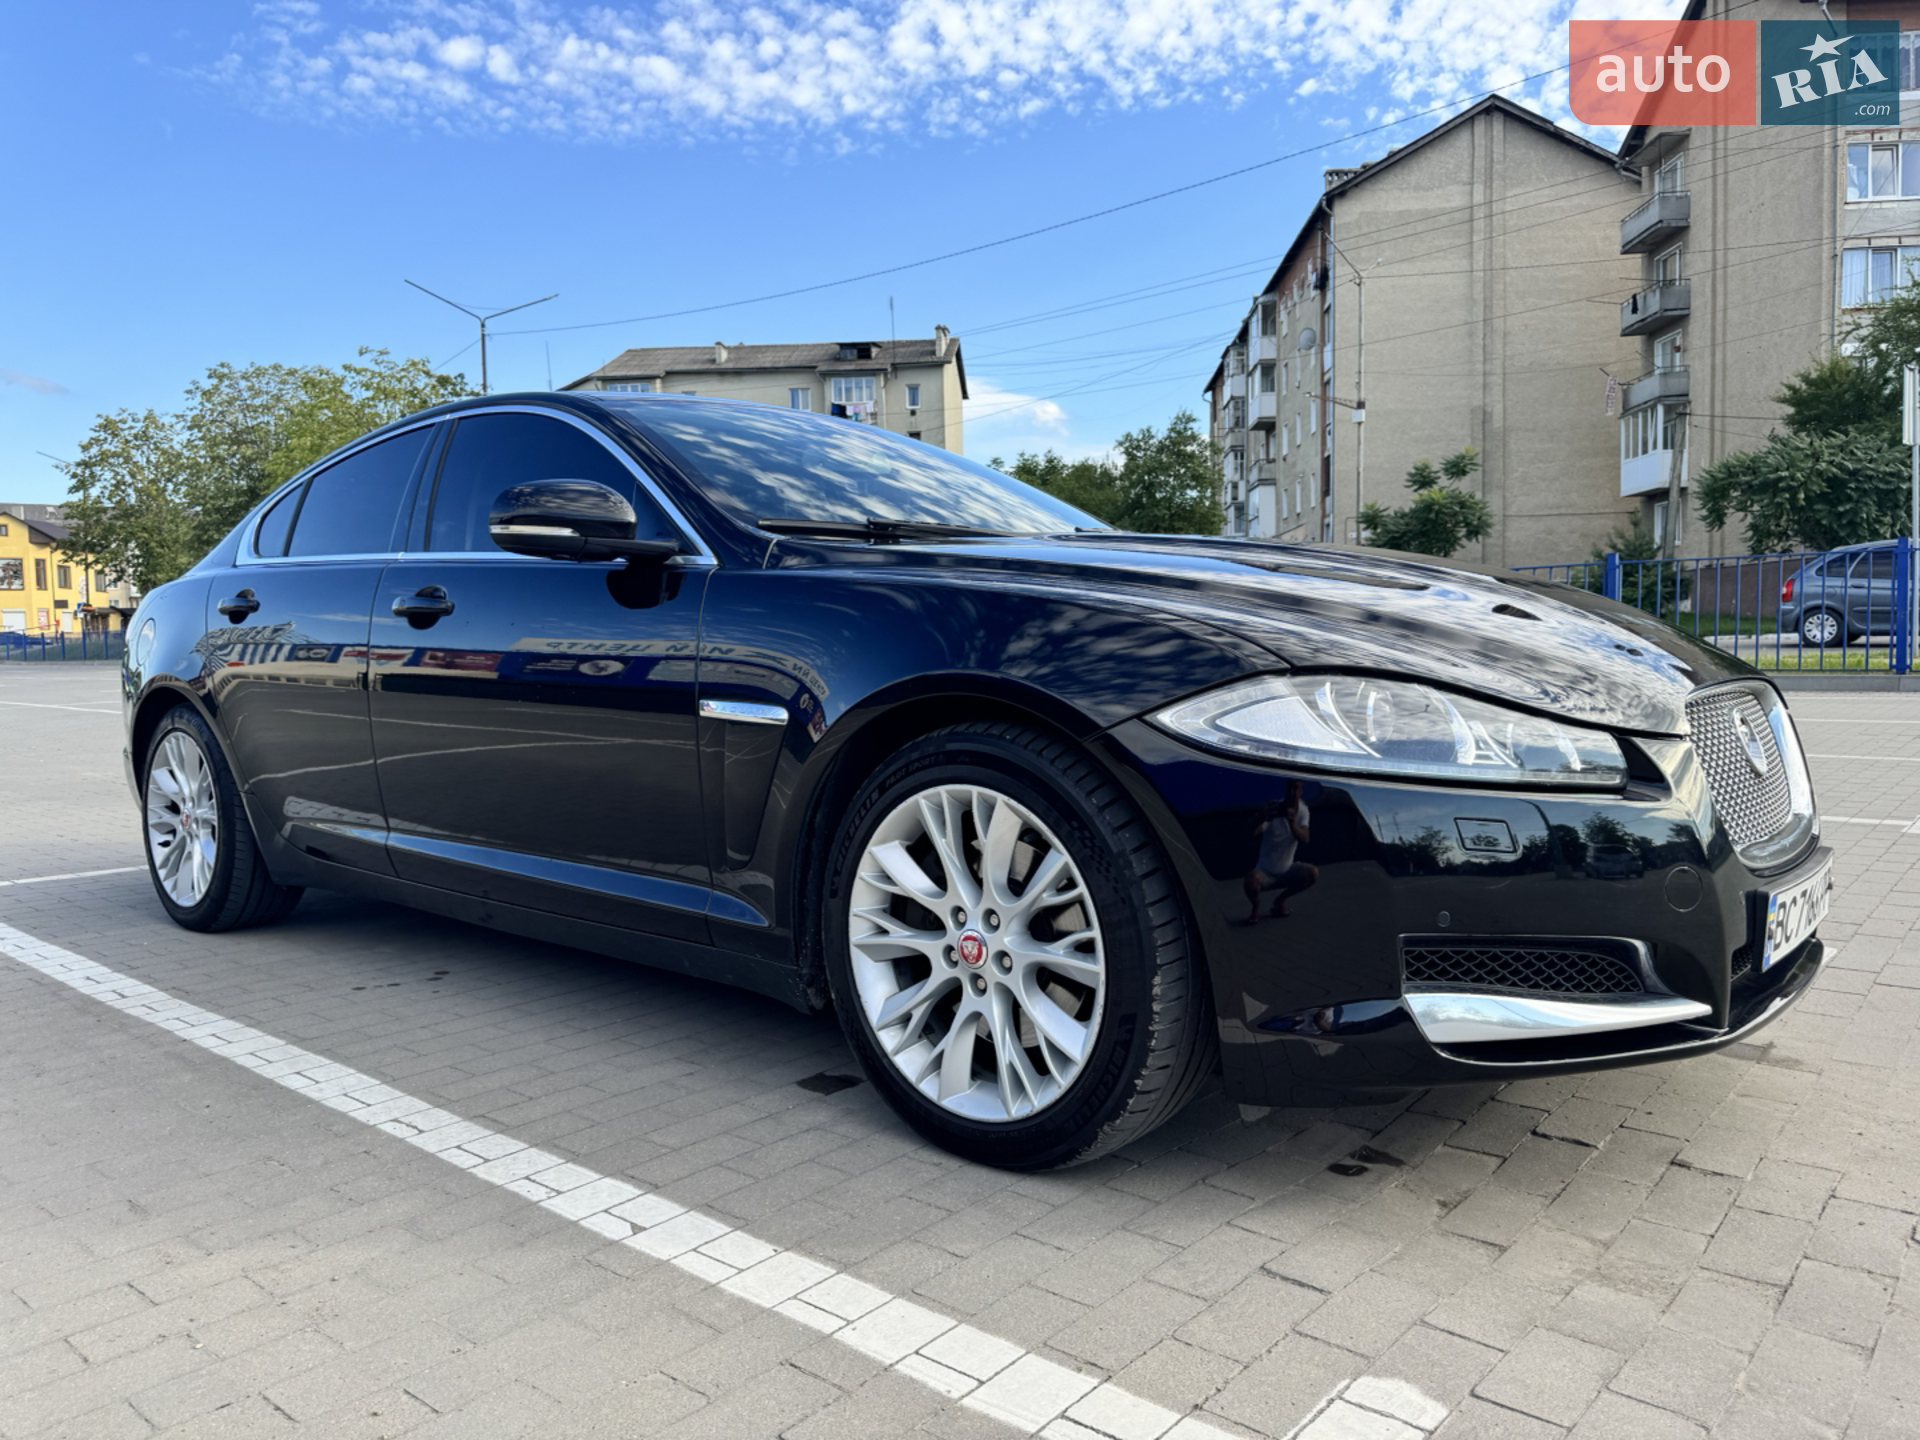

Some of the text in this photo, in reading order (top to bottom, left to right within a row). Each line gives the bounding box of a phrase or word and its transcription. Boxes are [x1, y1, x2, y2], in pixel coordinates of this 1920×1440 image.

[835, 788, 880, 871] MICHELIN
[885, 767, 907, 788] PILOT
[908, 756, 936, 773] SPORT
